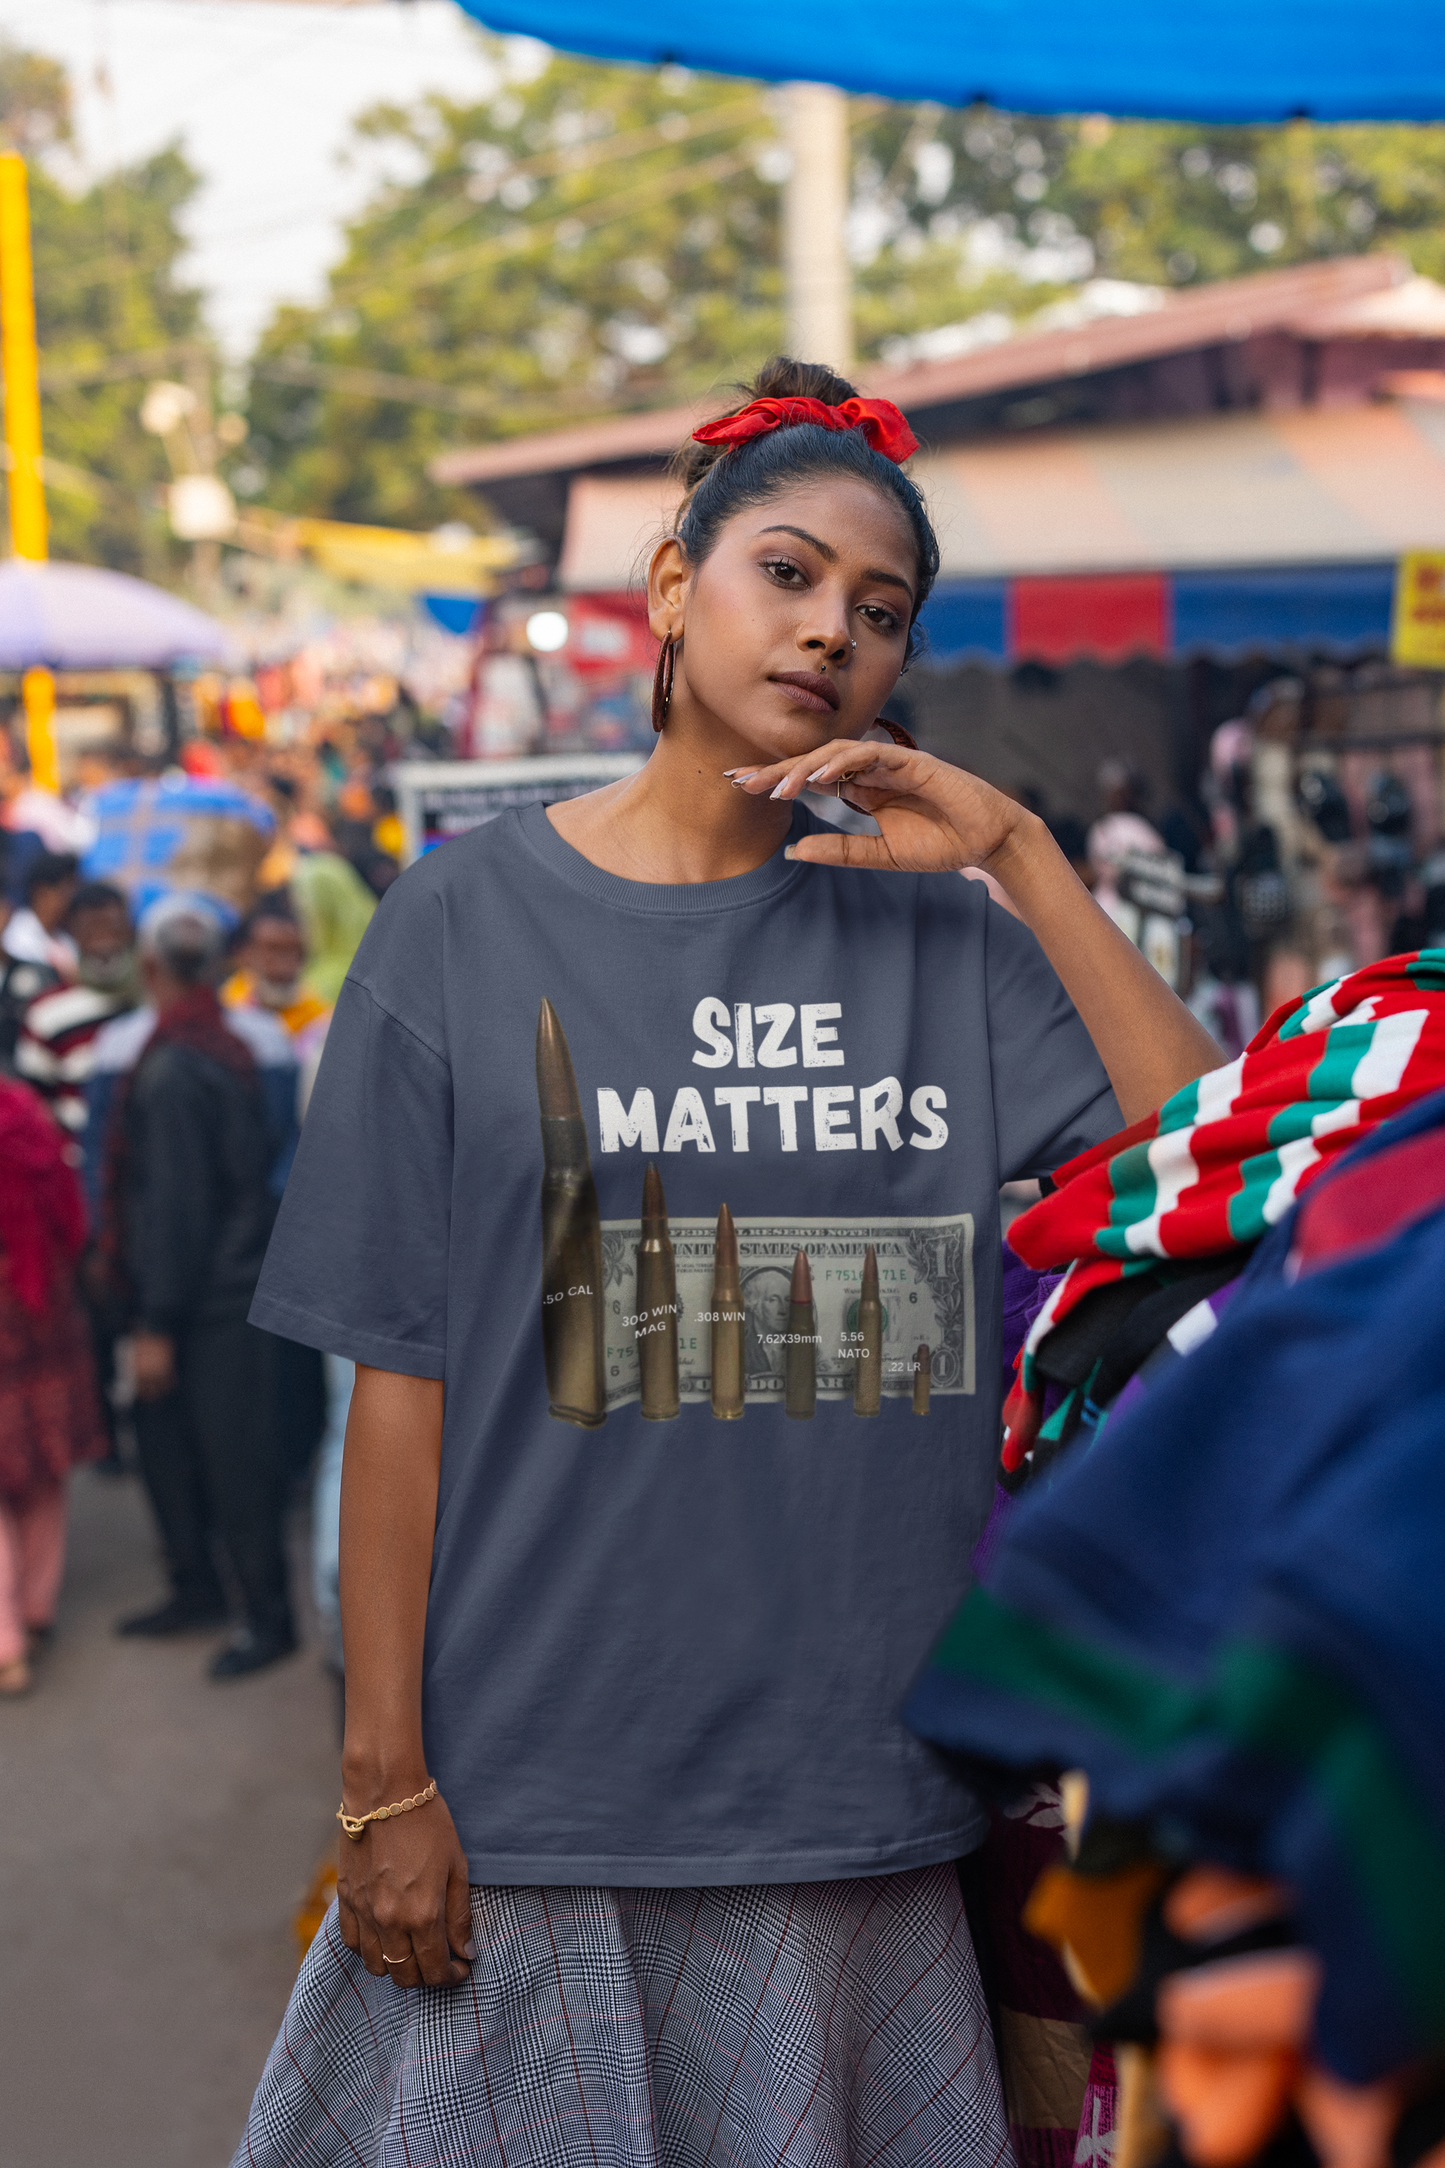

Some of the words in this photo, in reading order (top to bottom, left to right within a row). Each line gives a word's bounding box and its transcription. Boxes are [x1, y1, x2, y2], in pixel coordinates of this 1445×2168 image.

[692, 996, 845, 1068] SIZE
[597, 1076, 949, 1152] MATTERS
[740, 1242, 801, 1255] STATES
[804, 1242, 826, 1255] OF
[543, 1291, 564, 1305] .50
[567, 1285, 593, 1296] CAL
[621, 1311, 649, 1327] 300
[651, 1304, 678, 1317] WIN
[694, 1312, 720, 1322] .308
[722, 1312, 746, 1322] WIN
[634, 1321, 666, 1339] MAG
[756, 1334, 823, 1344] 7.62X39mm
[840, 1332, 865, 1342] 5.56
[837, 1348, 870, 1359] NATO
[888, 1362, 904, 1372] .22
[906, 1362, 921, 1372] LR
